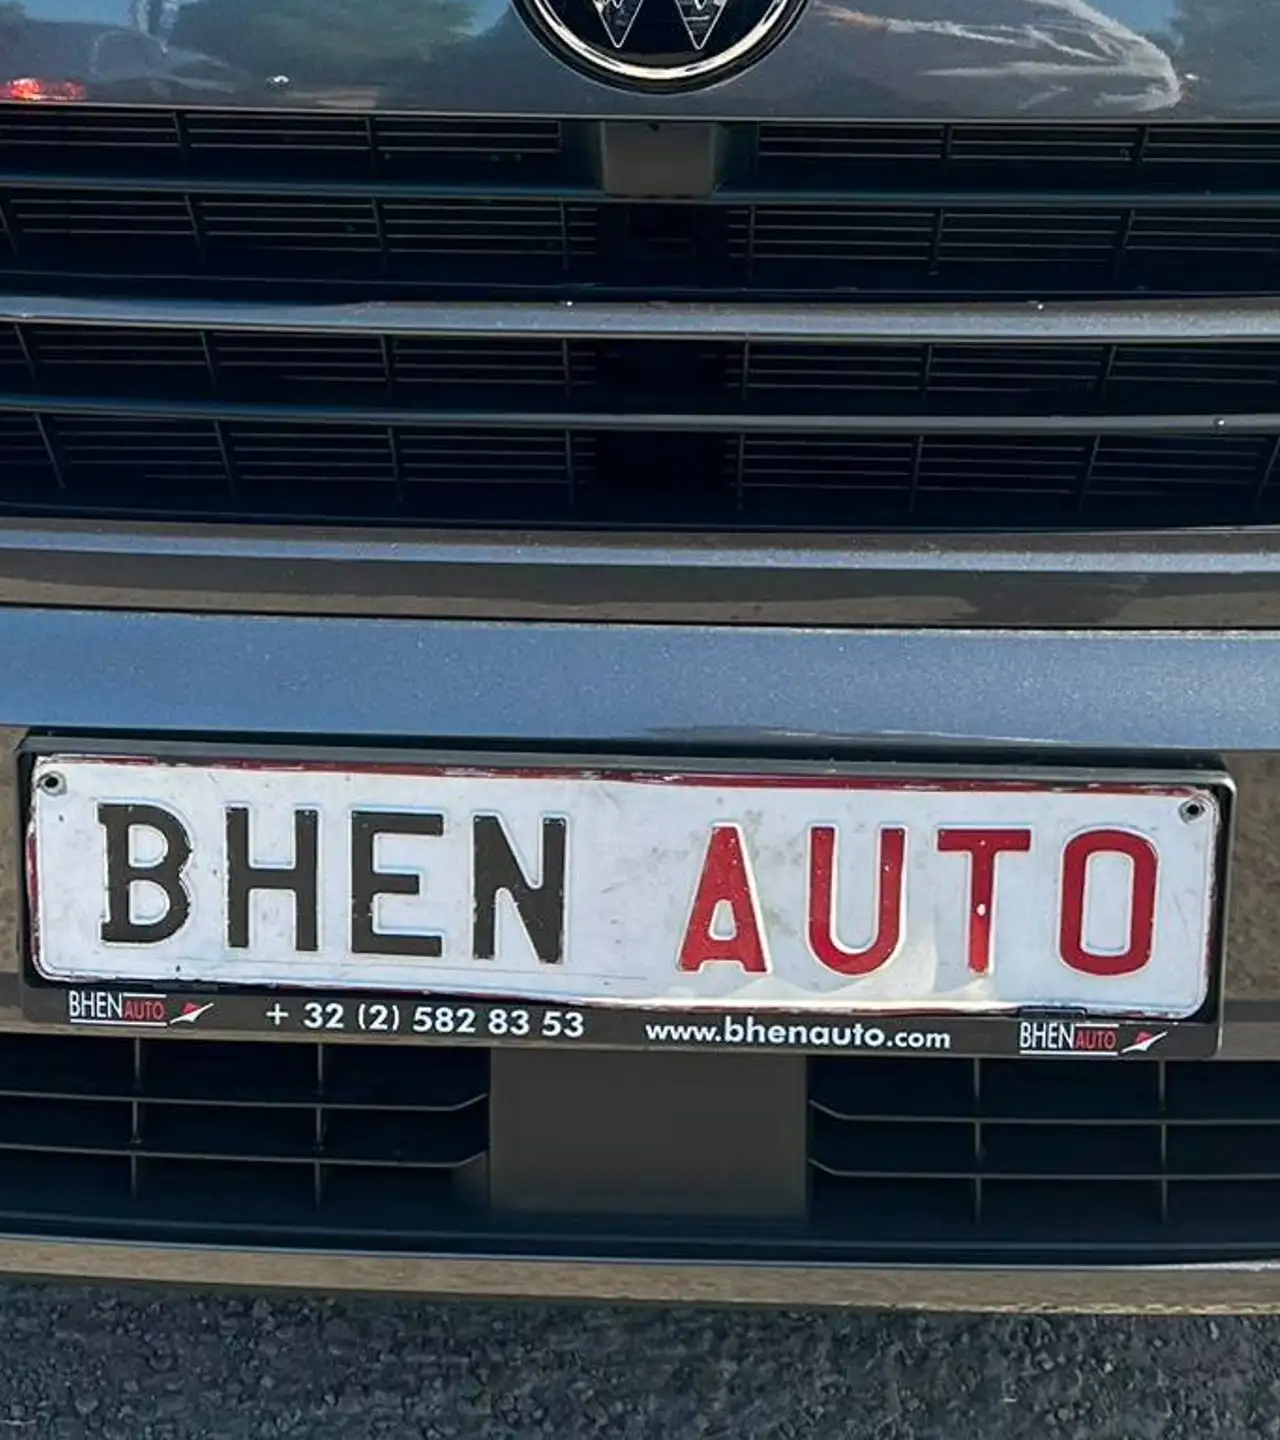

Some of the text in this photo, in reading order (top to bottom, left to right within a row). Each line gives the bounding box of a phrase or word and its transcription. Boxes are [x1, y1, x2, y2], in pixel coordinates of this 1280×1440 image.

[96, 801, 1161, 977] BHEN AUTO
[302, 1002, 345, 1030] 32
[357, 1003, 401, 1031] (2)
[412, 1006, 477, 1034] 582
[487, 1008, 530, 1036] 83
[541, 1010, 585, 1038] 53
[645, 1015, 952, 1050] www.bhenauto.com
